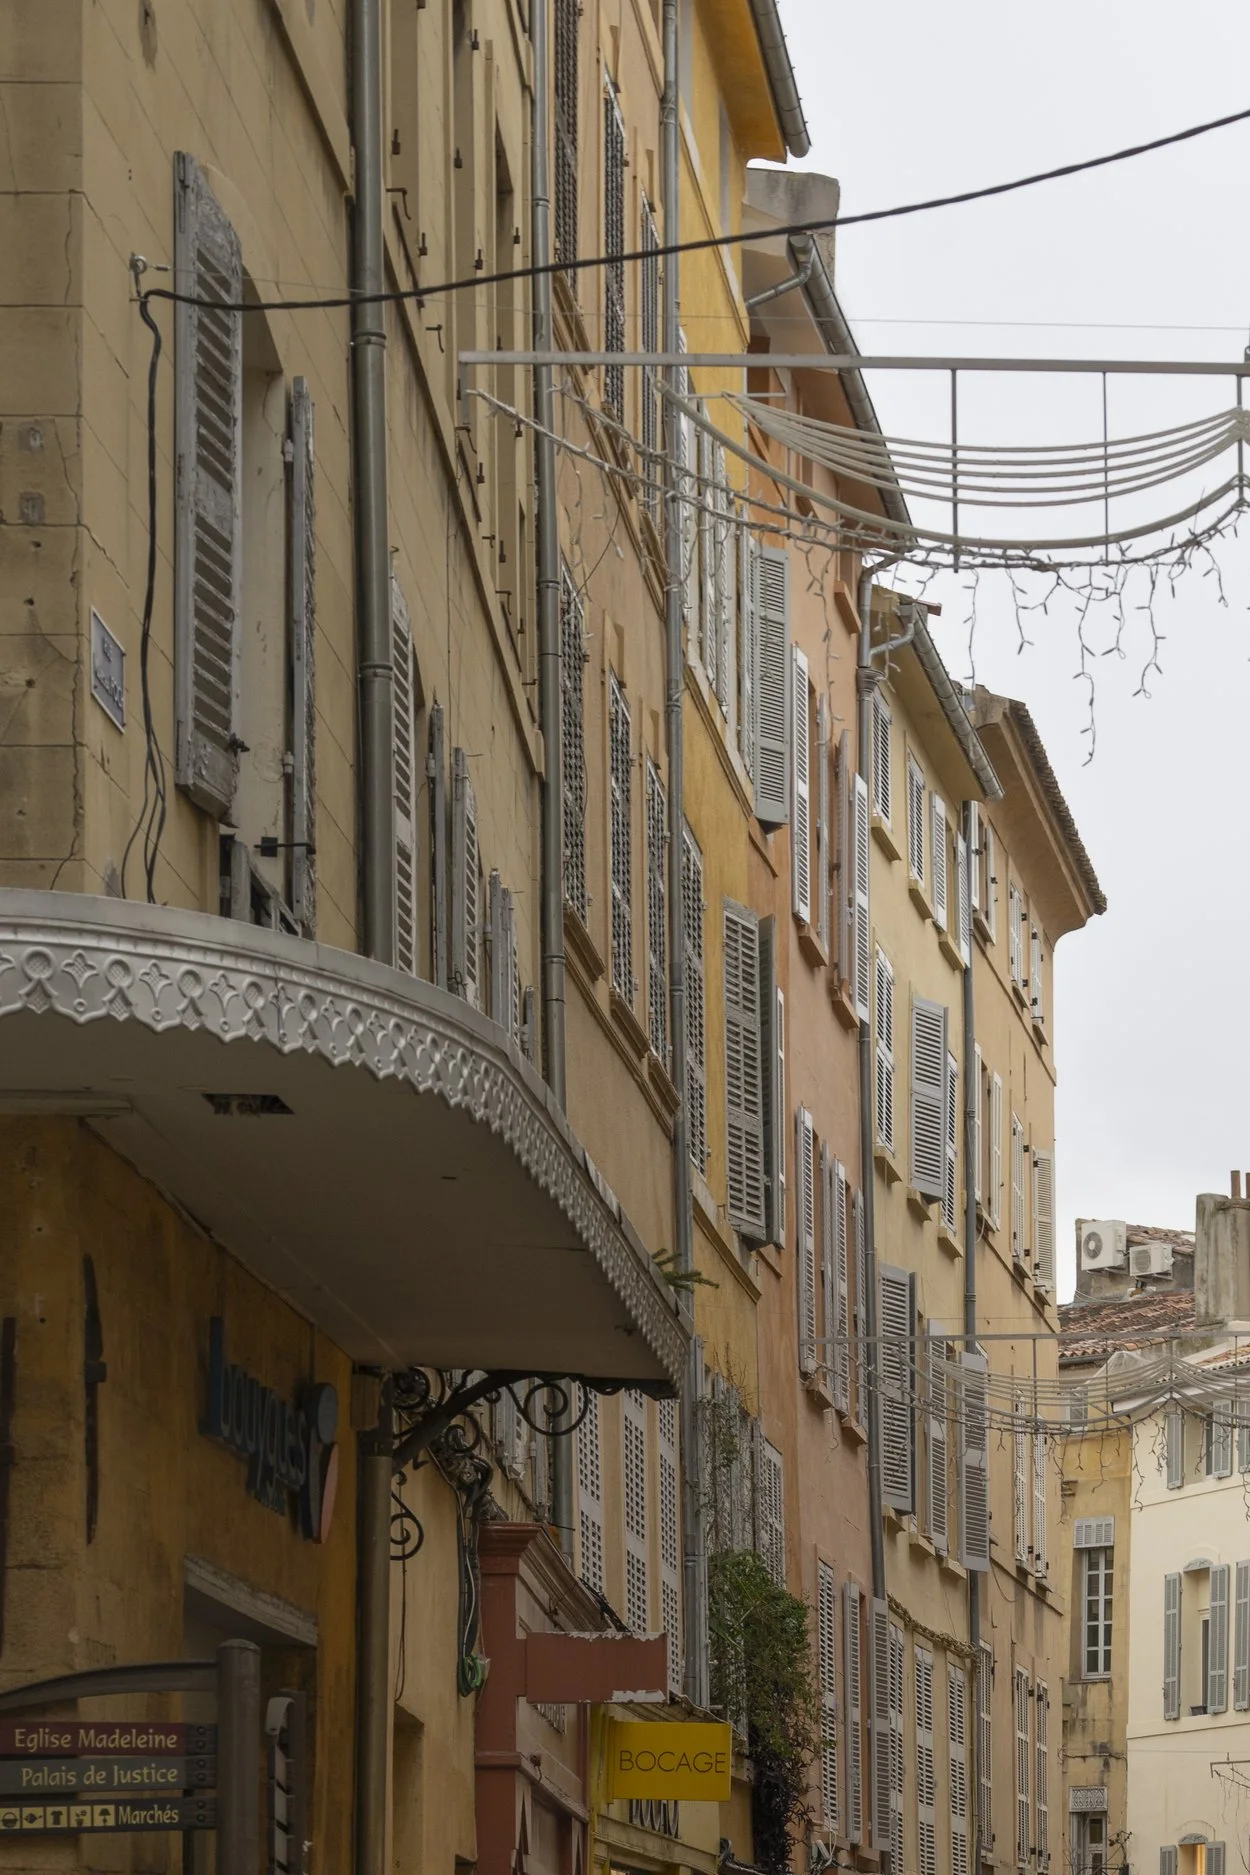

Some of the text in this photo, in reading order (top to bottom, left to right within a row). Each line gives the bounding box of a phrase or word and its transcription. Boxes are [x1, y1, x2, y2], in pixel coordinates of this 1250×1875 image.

[14, 1728, 178, 1752] Eglise Madeleine
[619, 1750, 726, 1774] BOCAGE
[21, 1763, 178, 1787] Palais de Justice
[118, 1804, 179, 1825] Marchés
